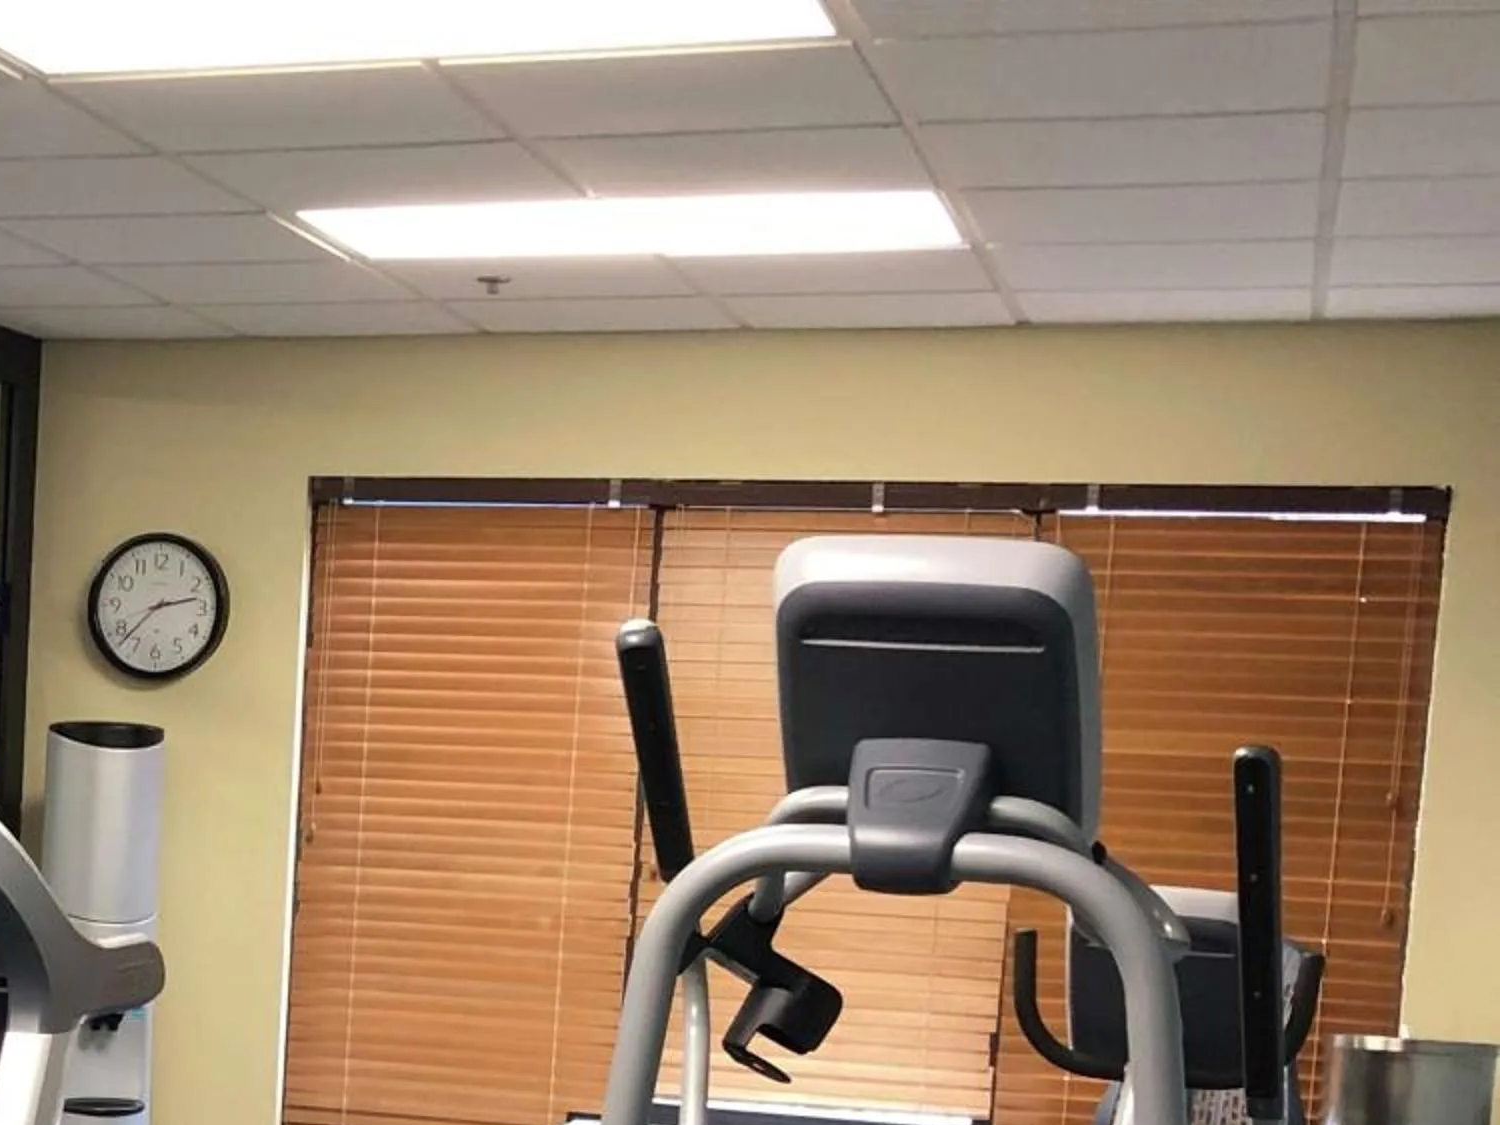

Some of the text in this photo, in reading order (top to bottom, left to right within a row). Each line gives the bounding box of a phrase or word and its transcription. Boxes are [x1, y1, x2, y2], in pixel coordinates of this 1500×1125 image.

[135, 559, 147, 575] 11
[154, 552, 169, 570] 12
[117, 574, 134, 592] 10
[190, 576, 201, 593] 2
